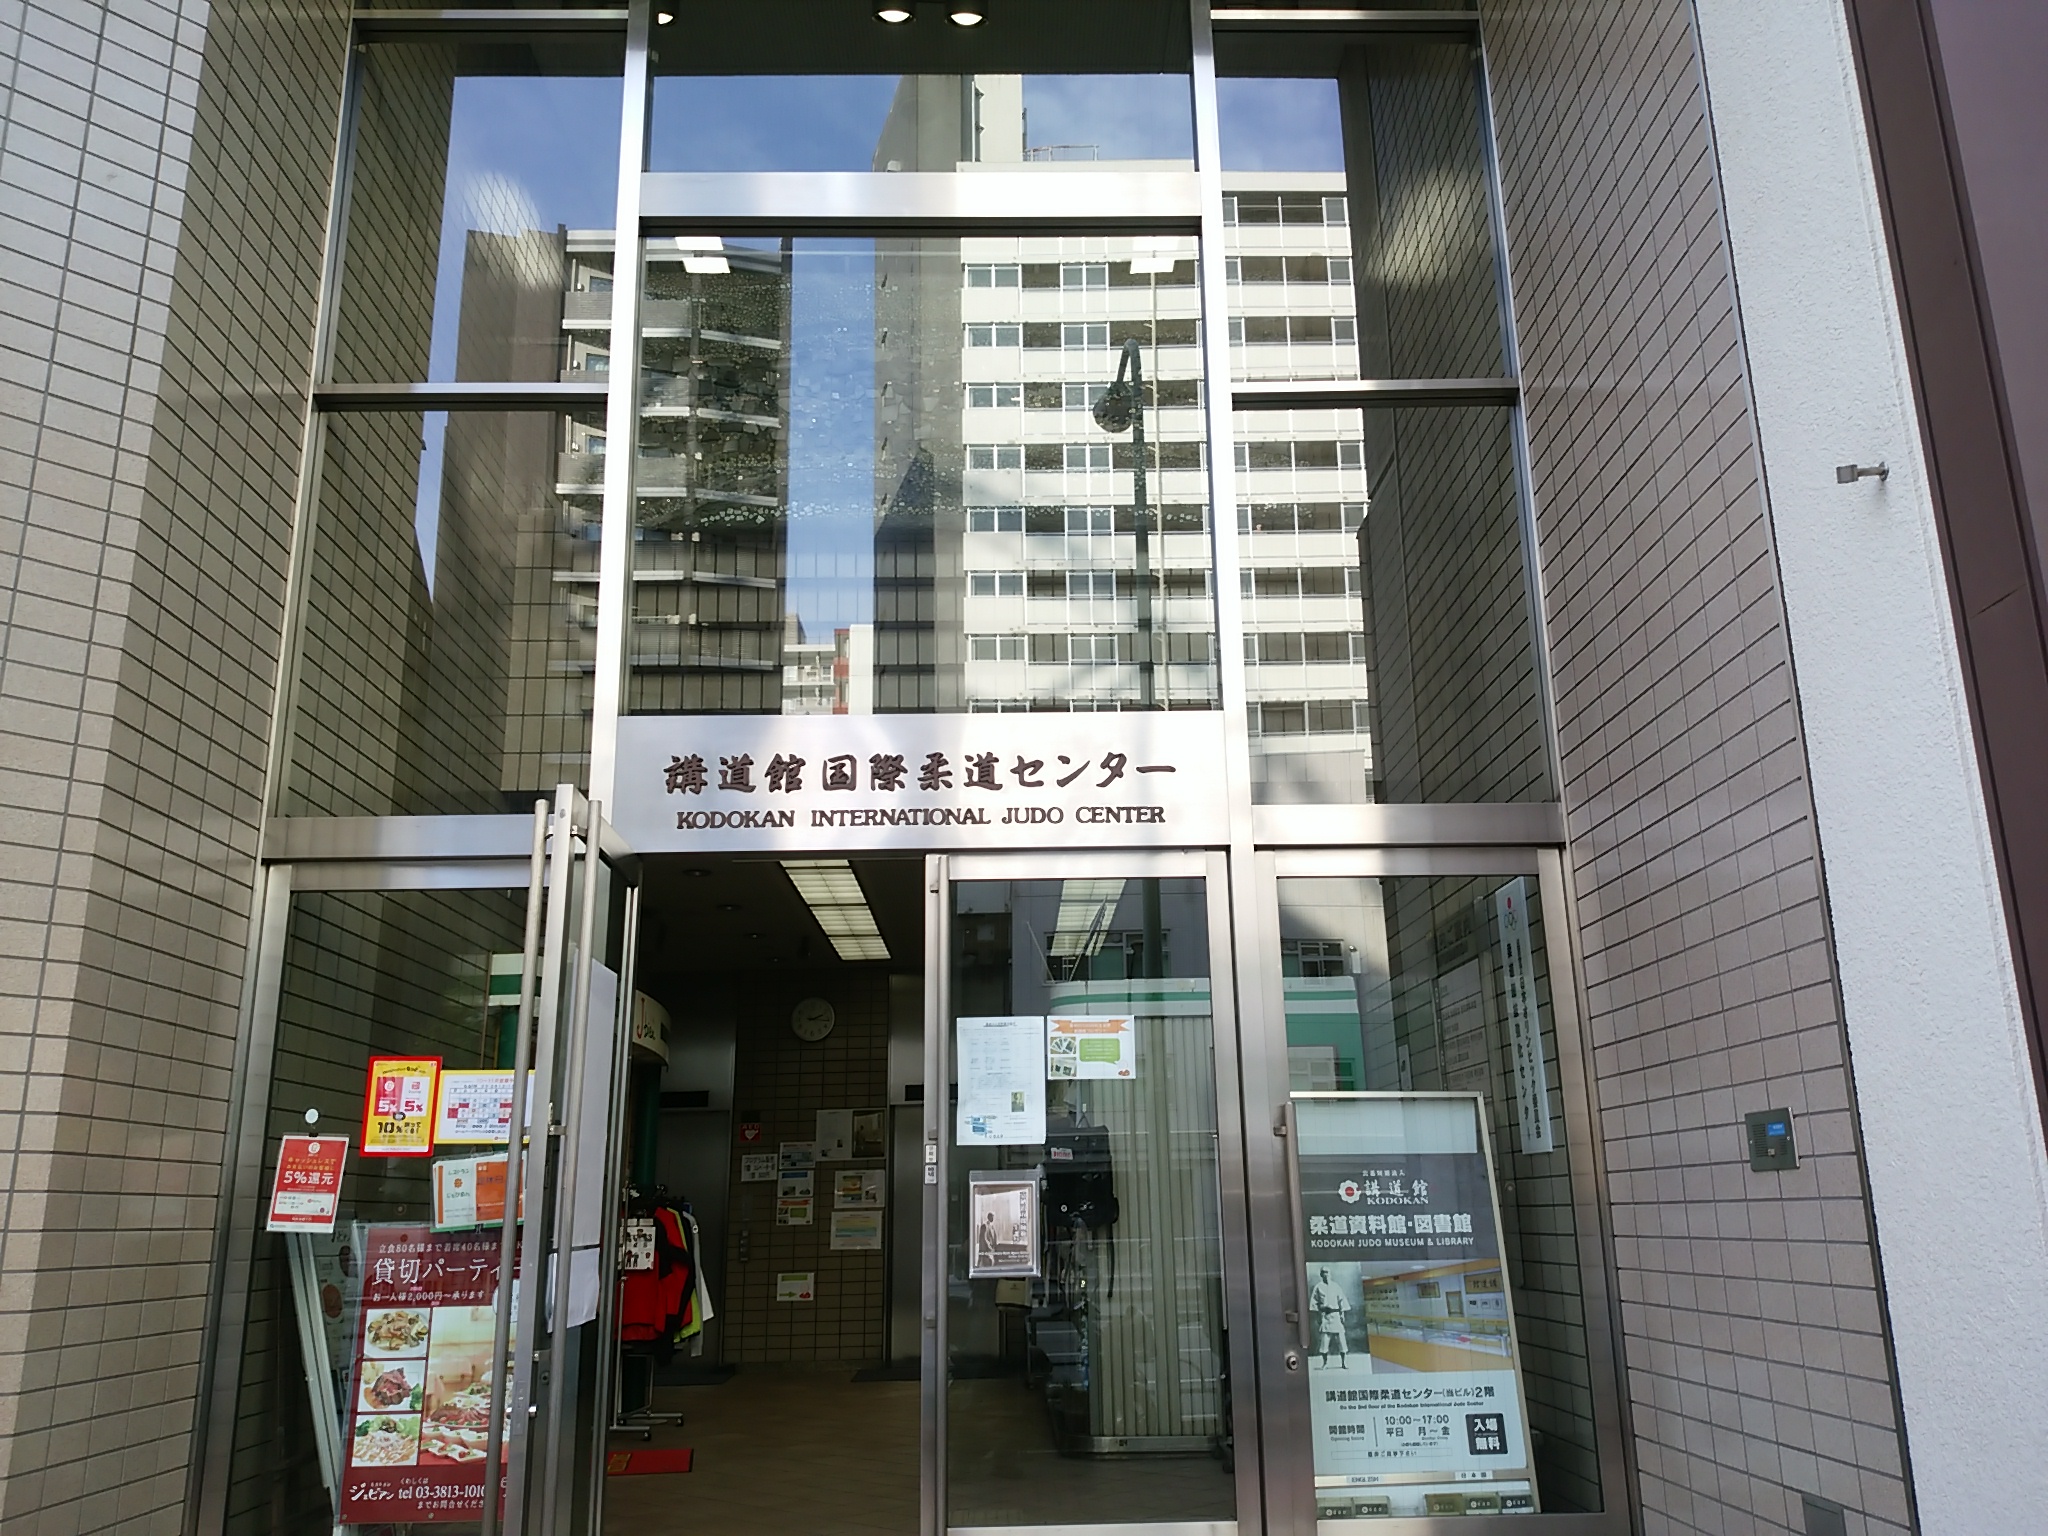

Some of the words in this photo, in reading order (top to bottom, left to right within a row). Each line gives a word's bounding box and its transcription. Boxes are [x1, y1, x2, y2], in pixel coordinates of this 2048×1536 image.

[662, 750, 1178, 796] 講道館国際柔道センター
[676, 809, 795, 830] KODOKAN
[810, 806, 992, 827] INTERNATIONAL
[1001, 806, 1064, 825] JUDO
[1075, 805, 1166, 824] CENTER
[378, 1100, 398, 1112] 5%
[404, 1100, 424, 1112] 5%
[283, 1170, 334, 1185] 5%還元
[1364, 1179, 1429, 1197] 講道館
[1366, 1196, 1430, 1205] KODOKAN
[1311, 1239, 1355, 1248] KODOKAN
[1357, 1238, 1382, 1248] JUDO
[1384, 1238, 1425, 1247] MUSEUM
[1436, 1237, 1474, 1246] LIBRARY
[1474, 1418, 1497, 1432] 入場
[1385, 1427, 1404, 1437] 平日
[1475, 1436, 1500, 1451] 無料
[398, 1486, 413, 1499] tel
[417, 1499, 484, 1510] までお問合せくださ
